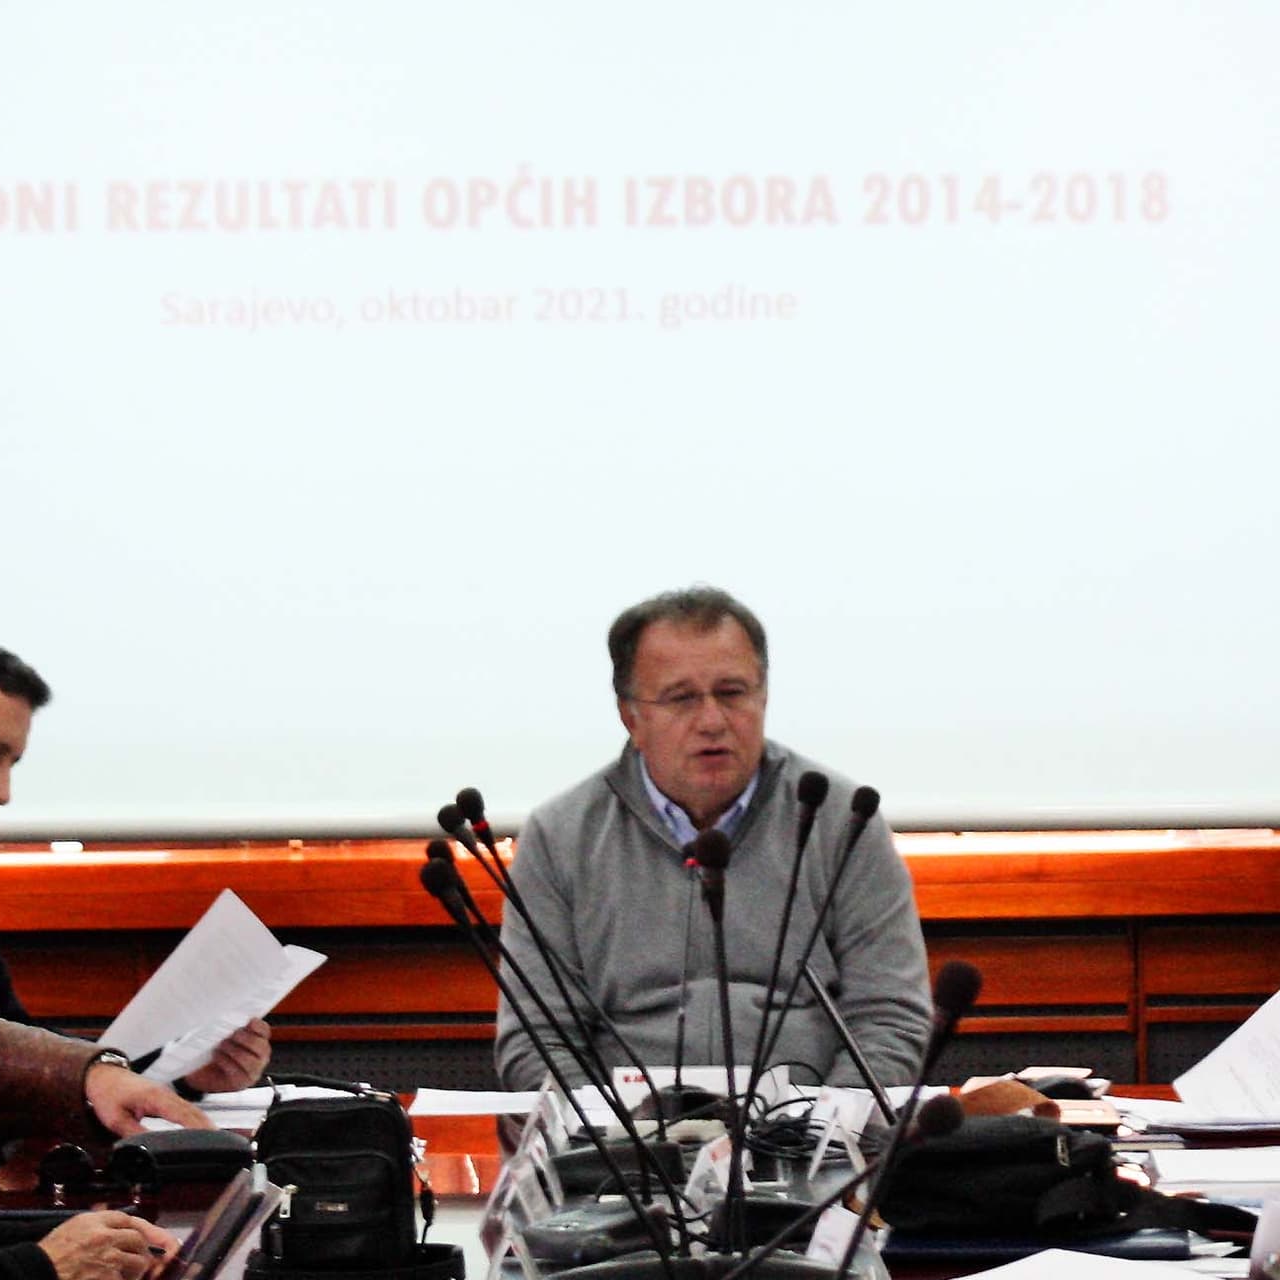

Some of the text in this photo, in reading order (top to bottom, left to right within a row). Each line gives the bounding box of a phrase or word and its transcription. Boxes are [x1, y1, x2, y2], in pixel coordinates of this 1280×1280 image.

[104, 178, 397, 233] REZULTATI
[623, 173, 840, 228] IZBORA
[861, 169, 1172, 228] 2014-2018
[159, 281, 799, 332] Sarajevo, oktobar 2021. godine
